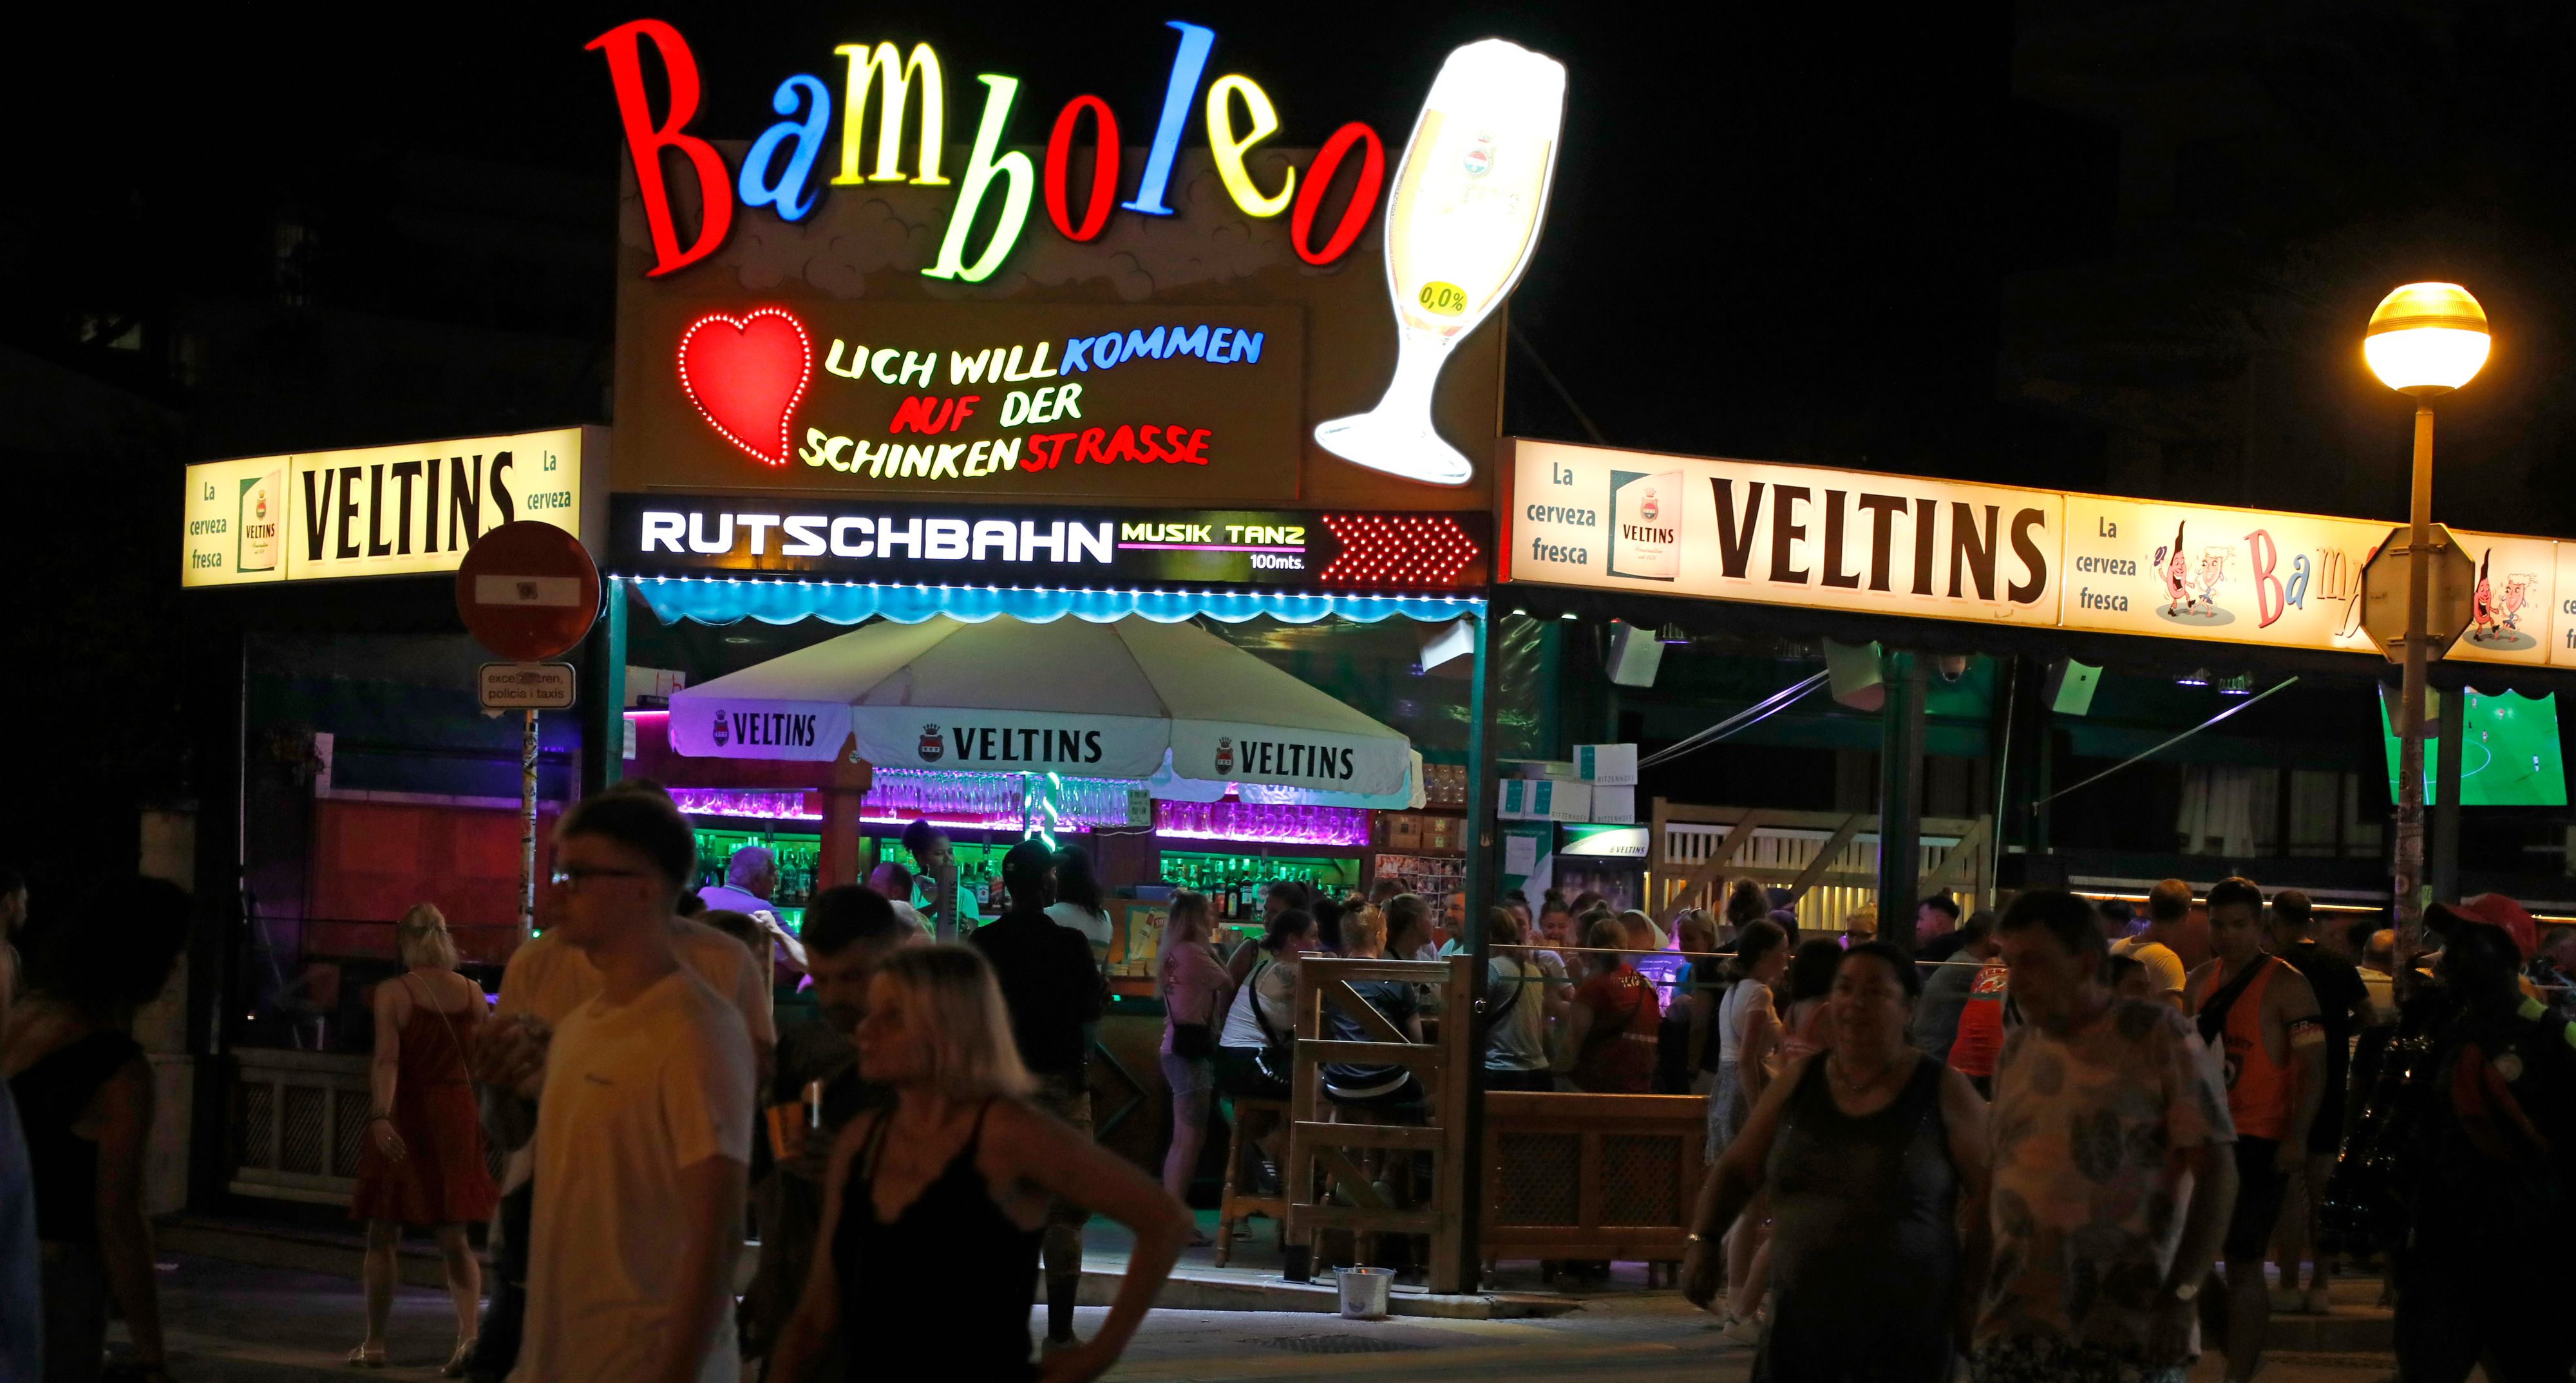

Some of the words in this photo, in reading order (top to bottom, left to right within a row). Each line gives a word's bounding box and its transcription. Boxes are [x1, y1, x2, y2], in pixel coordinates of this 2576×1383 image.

[585, 18, 1385, 283] Bamboleo
[1420, 286, 1464, 312] 0,0%
[824, 337, 938, 389] LICH
[888, 394, 981, 436] AUF
[999, 382, 1083, 428] DER
[544, 449, 557, 472] La
[798, 424, 1213, 481] SCHINKENSTRASSE
[1553, 461, 1573, 486] La
[204, 481, 216, 502] La
[527, 490, 572, 511] cerveza
[301, 451, 514, 561] VELTINS
[1526, 503, 1596, 527] cerveza
[189, 518, 227, 536] cerveza
[246, 523, 275, 538] VELTINS
[641, 511, 1114, 564] RUTSCHBAHN
[1121, 522, 1213, 543] MUSIK
[1224, 523, 1306, 545] TANZ
[1623, 523, 1674, 544] VELTINS
[2099, 516, 2117, 539] La
[1531, 536, 1588, 565] fresca
[1709, 476, 2048, 605] VELTINS
[192, 548, 222, 570] fresca
[1249, 554, 1305, 570] 100mts.
[2076, 556, 2137, 576] cerveza
[2080, 587, 2128, 612] fresca
[536, 688, 565, 699] taxis
[733, 712, 817, 748] VELTINS
[952, 727, 1103, 764] VELTINS
[1240, 740, 1354, 780] VELTINS
[1616, 845, 1645, 854] VELTINS
